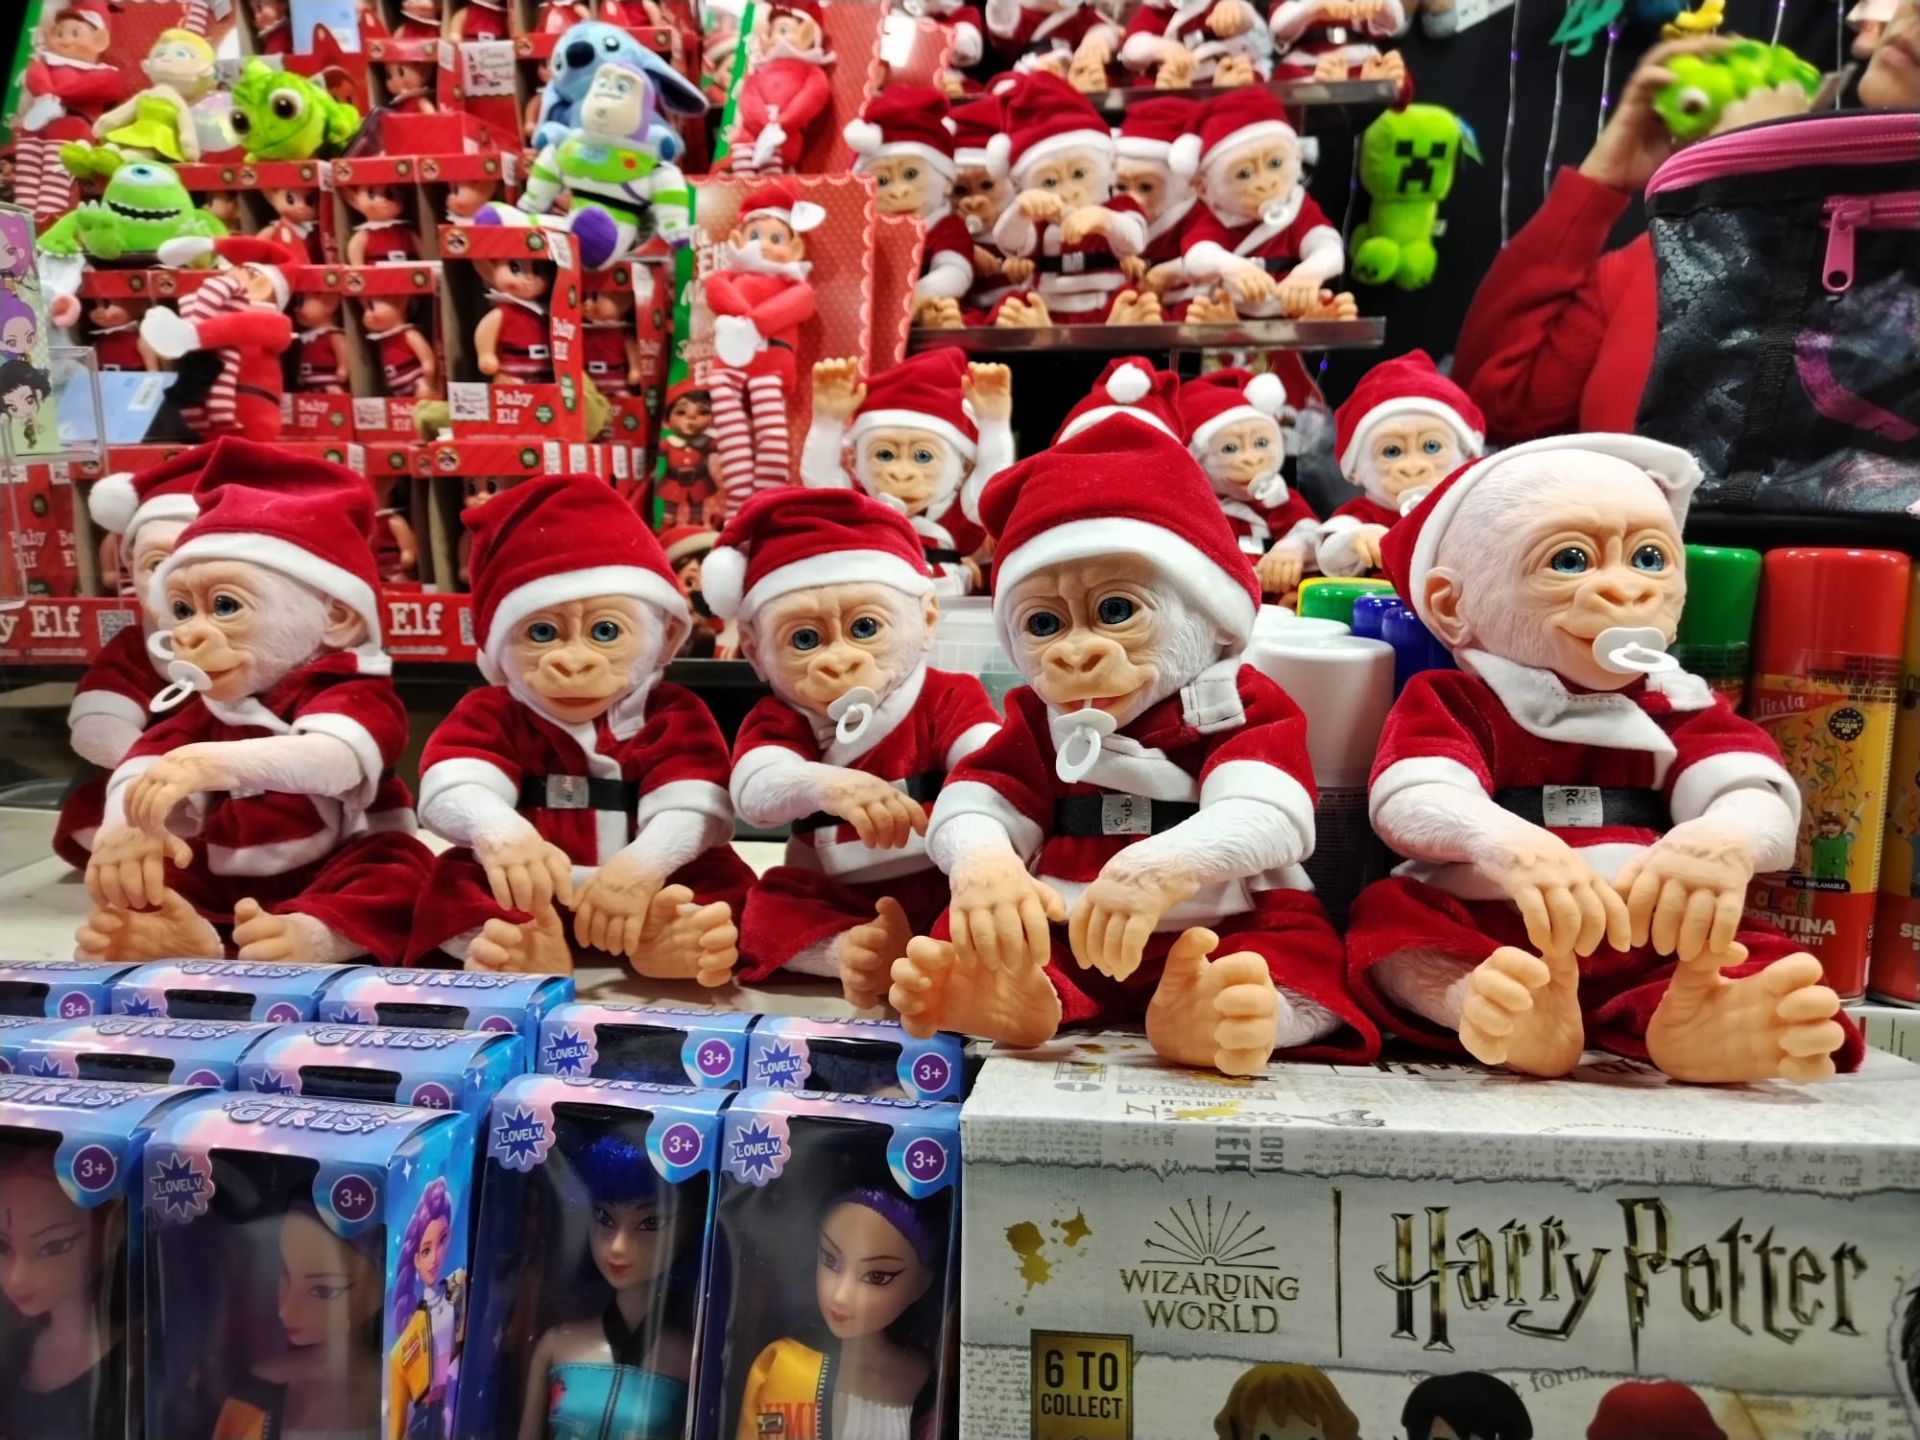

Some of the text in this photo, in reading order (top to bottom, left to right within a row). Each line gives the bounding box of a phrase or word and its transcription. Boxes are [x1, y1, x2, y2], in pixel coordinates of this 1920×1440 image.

[495, 389, 534, 407] Baby
[28, 605, 81, 638] Elf
[388, 602, 443, 636] Elf
[64, 1002, 87, 1018] 3+
[548, 1045, 589, 1061] LOVELY
[703, 1049, 726, 1066] 3+
[759, 1058, 801, 1076] LOVELY
[919, 1064, 943, 1081] 3+
[229, 1104, 372, 1134] GIRLS
[500, 1126, 545, 1145] LOVELY
[669, 1135, 694, 1154] 3+
[736, 1140, 781, 1158] LOVELY
[81, 1159, 107, 1178] 3+
[912, 1150, 938, 1169] 3+
[156, 1176, 203, 1194] LOVELY
[340, 1188, 367, 1208] 3+
[1119, 1268, 1300, 1302] WIZARDING
[1374, 1197, 1869, 1374] Harry Potter
[1142, 1300, 1279, 1334] WORLD
[1044, 1348, 1119, 1392] 6 TO
[1040, 1392, 1123, 1420] COLLECT
